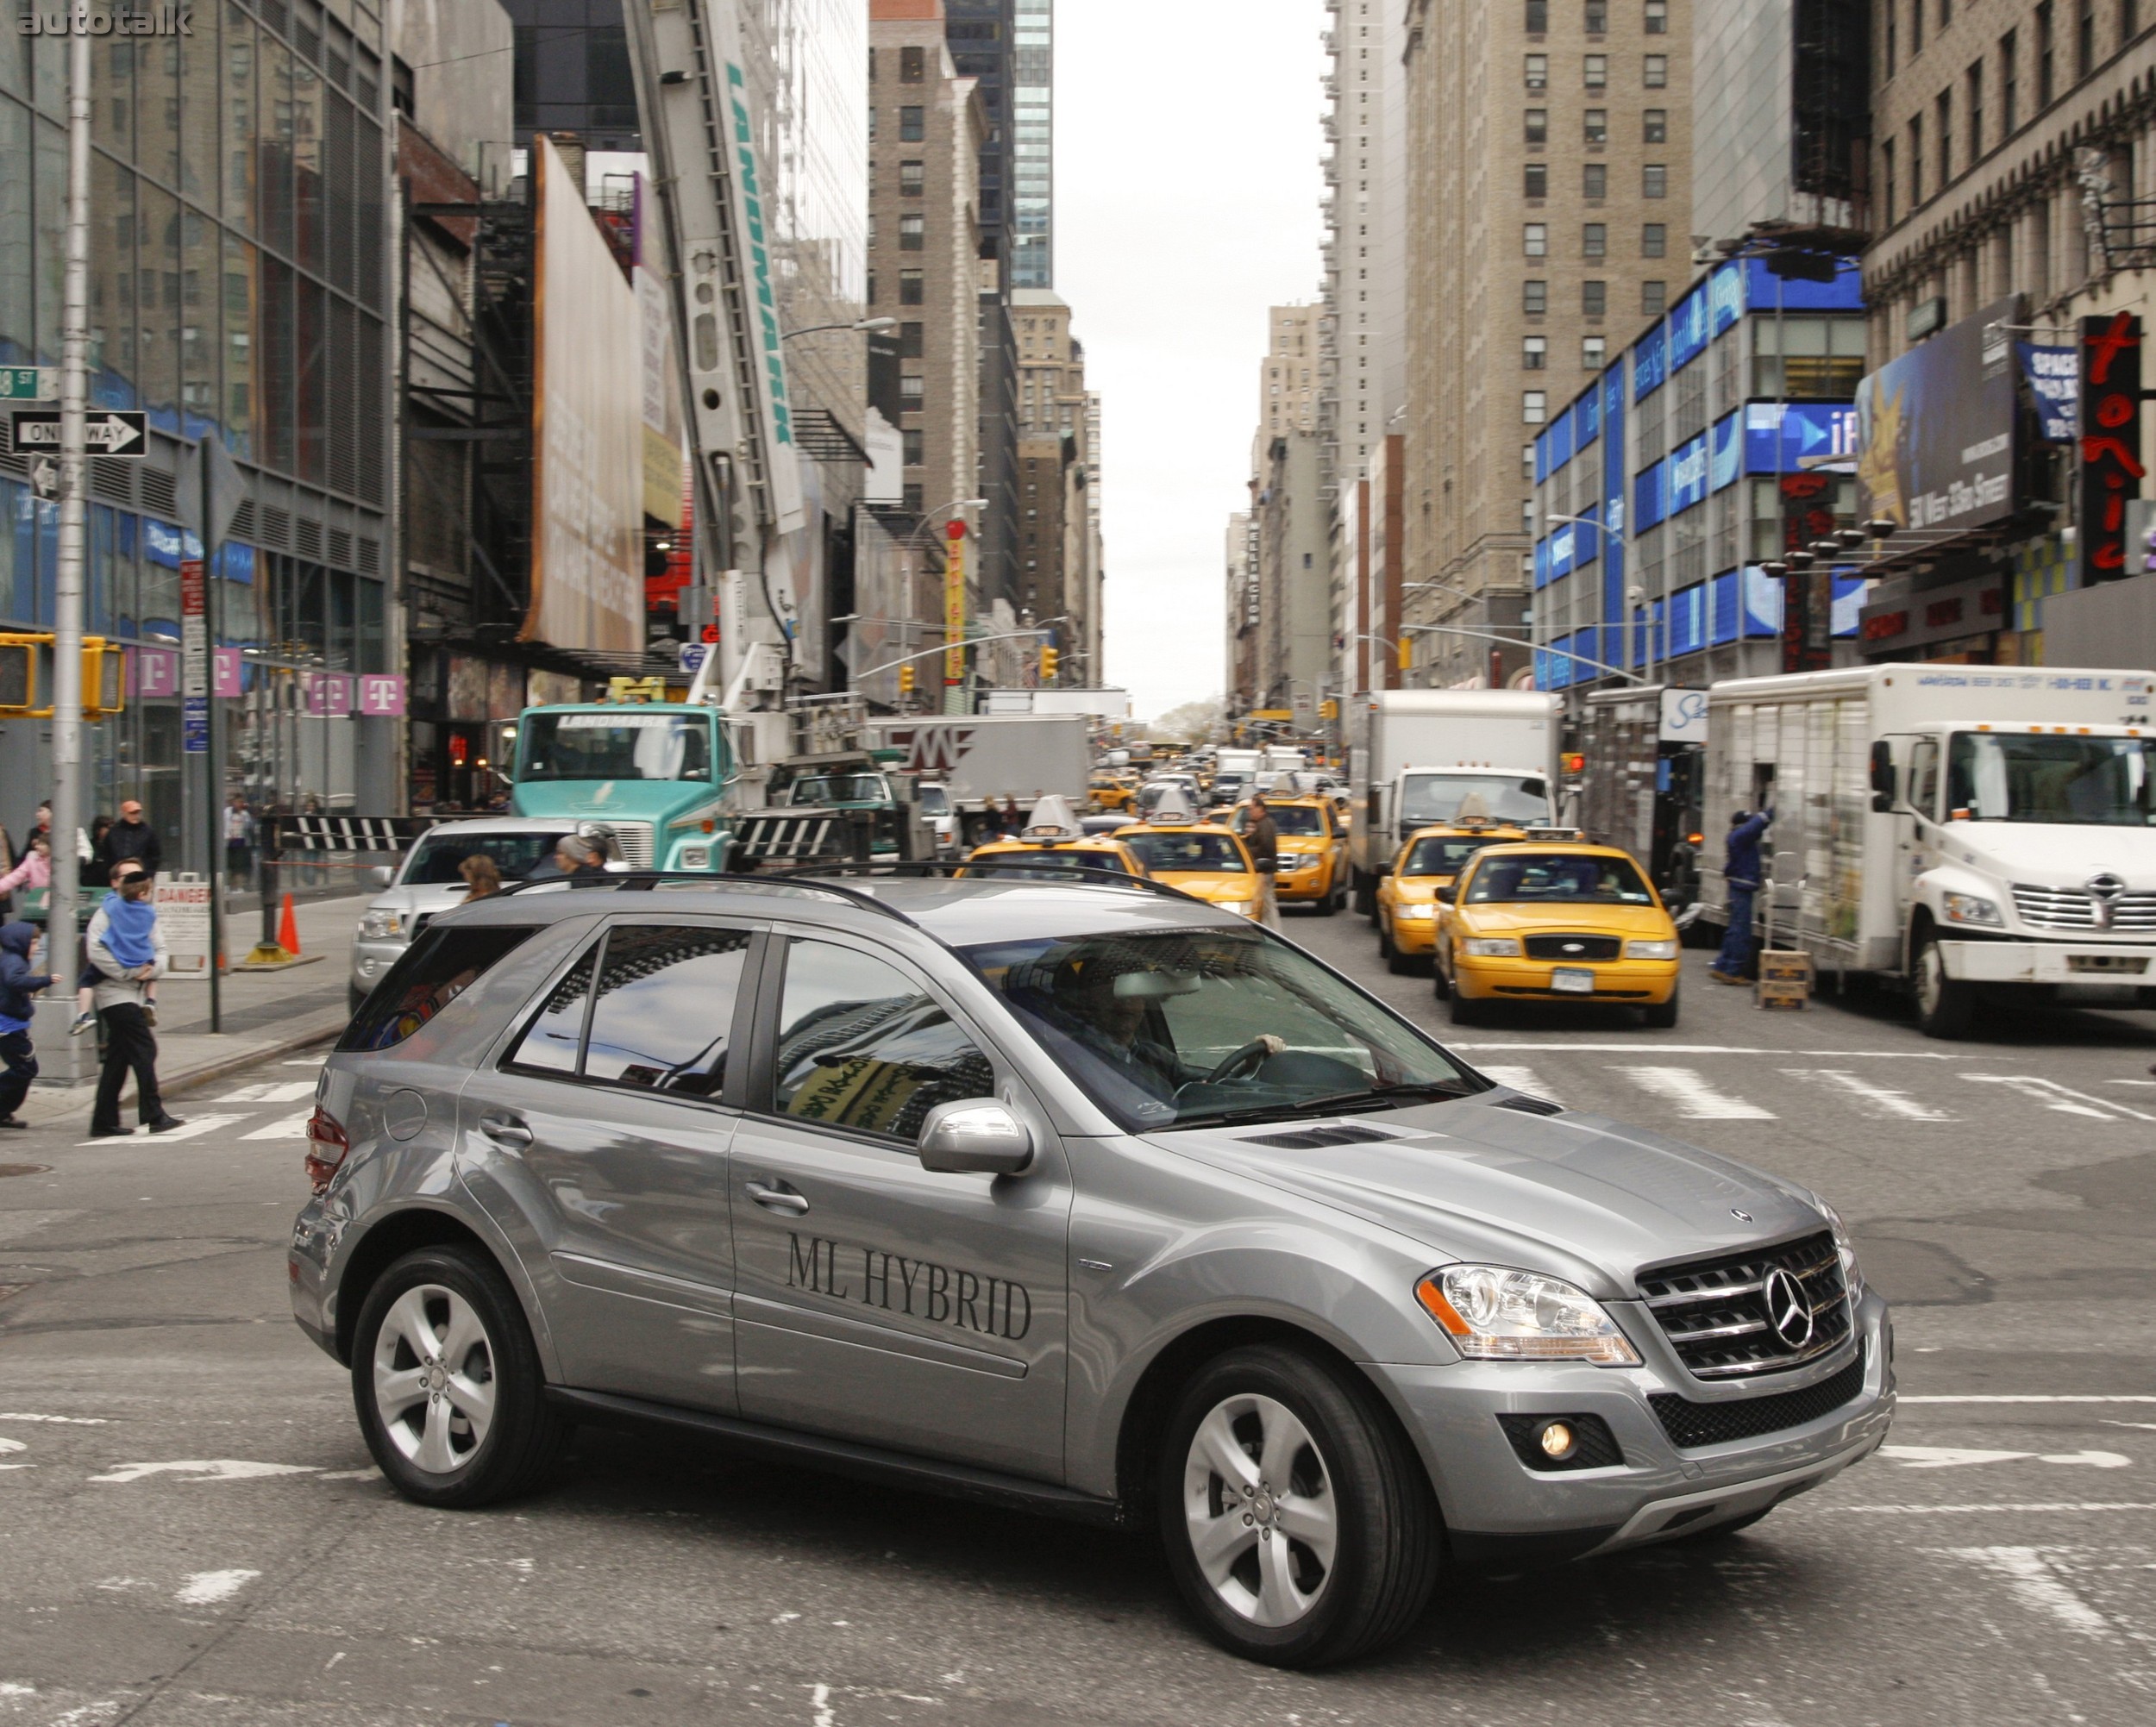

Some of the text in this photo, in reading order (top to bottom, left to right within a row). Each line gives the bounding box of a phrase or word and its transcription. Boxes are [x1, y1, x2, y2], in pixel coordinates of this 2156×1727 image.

[725, 62, 793, 447] LANDMARK
[0, 371, 34, 396] 8 ST
[86, 426, 126, 442] WAY
[1248, 522, 1260, 624] WELLINGTON
[369, 679, 398, 710] T
[557, 715, 670, 729] LANDMARK
[786, 1231, 1032, 1341] ML HYBRID
